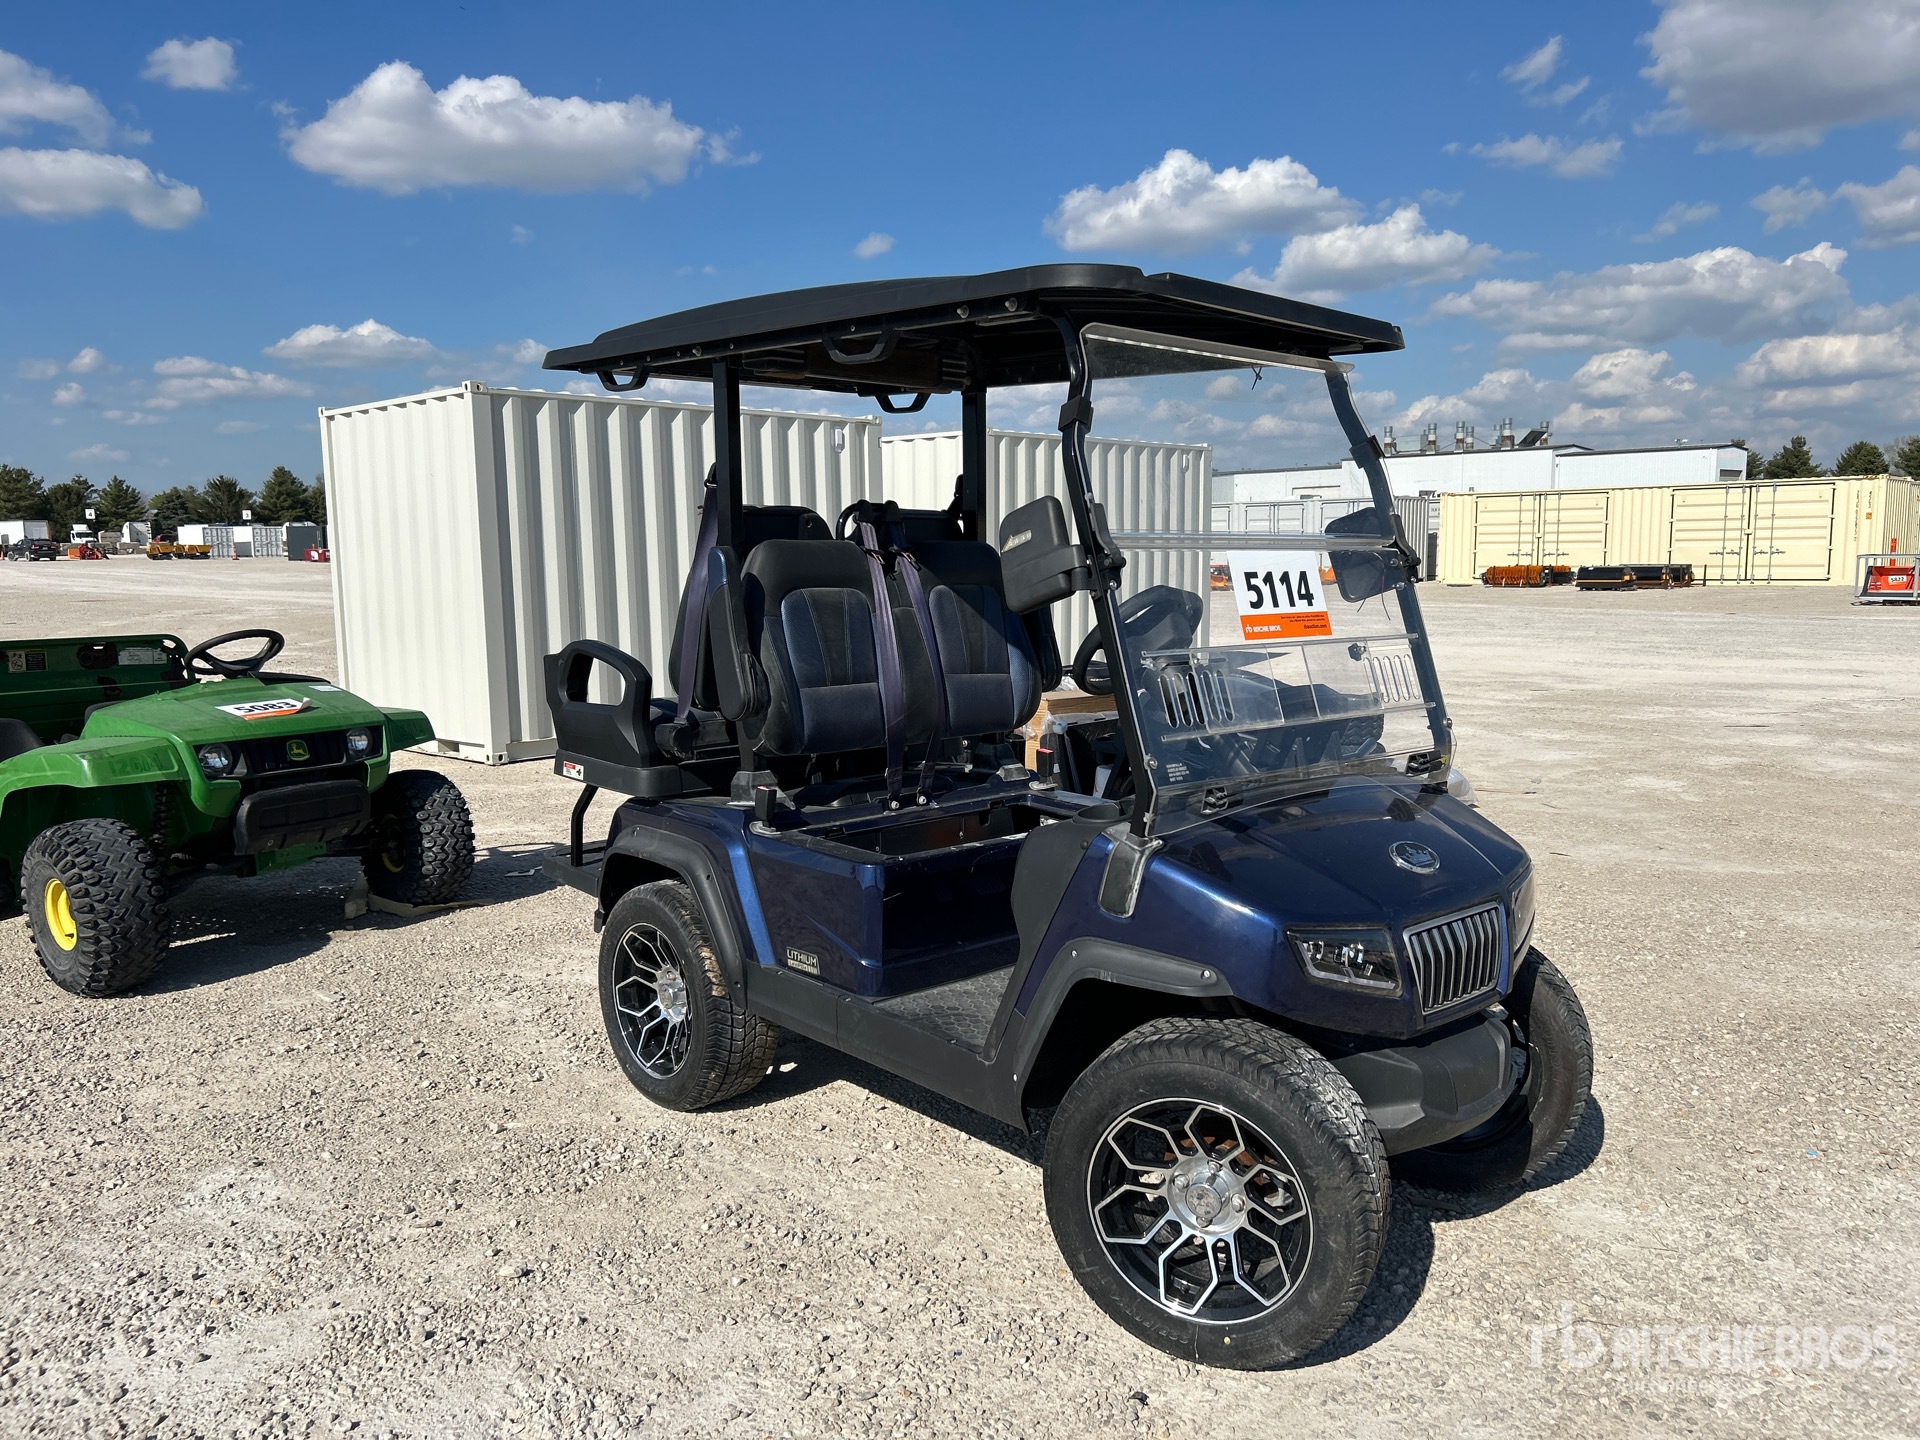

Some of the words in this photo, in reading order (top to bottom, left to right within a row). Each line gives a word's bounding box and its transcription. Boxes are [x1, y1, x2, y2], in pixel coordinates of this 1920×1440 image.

[1244, 571, 1315, 609] 5114
[233, 701, 297, 713] 5083
[787, 949, 817, 967] LITHIUM
